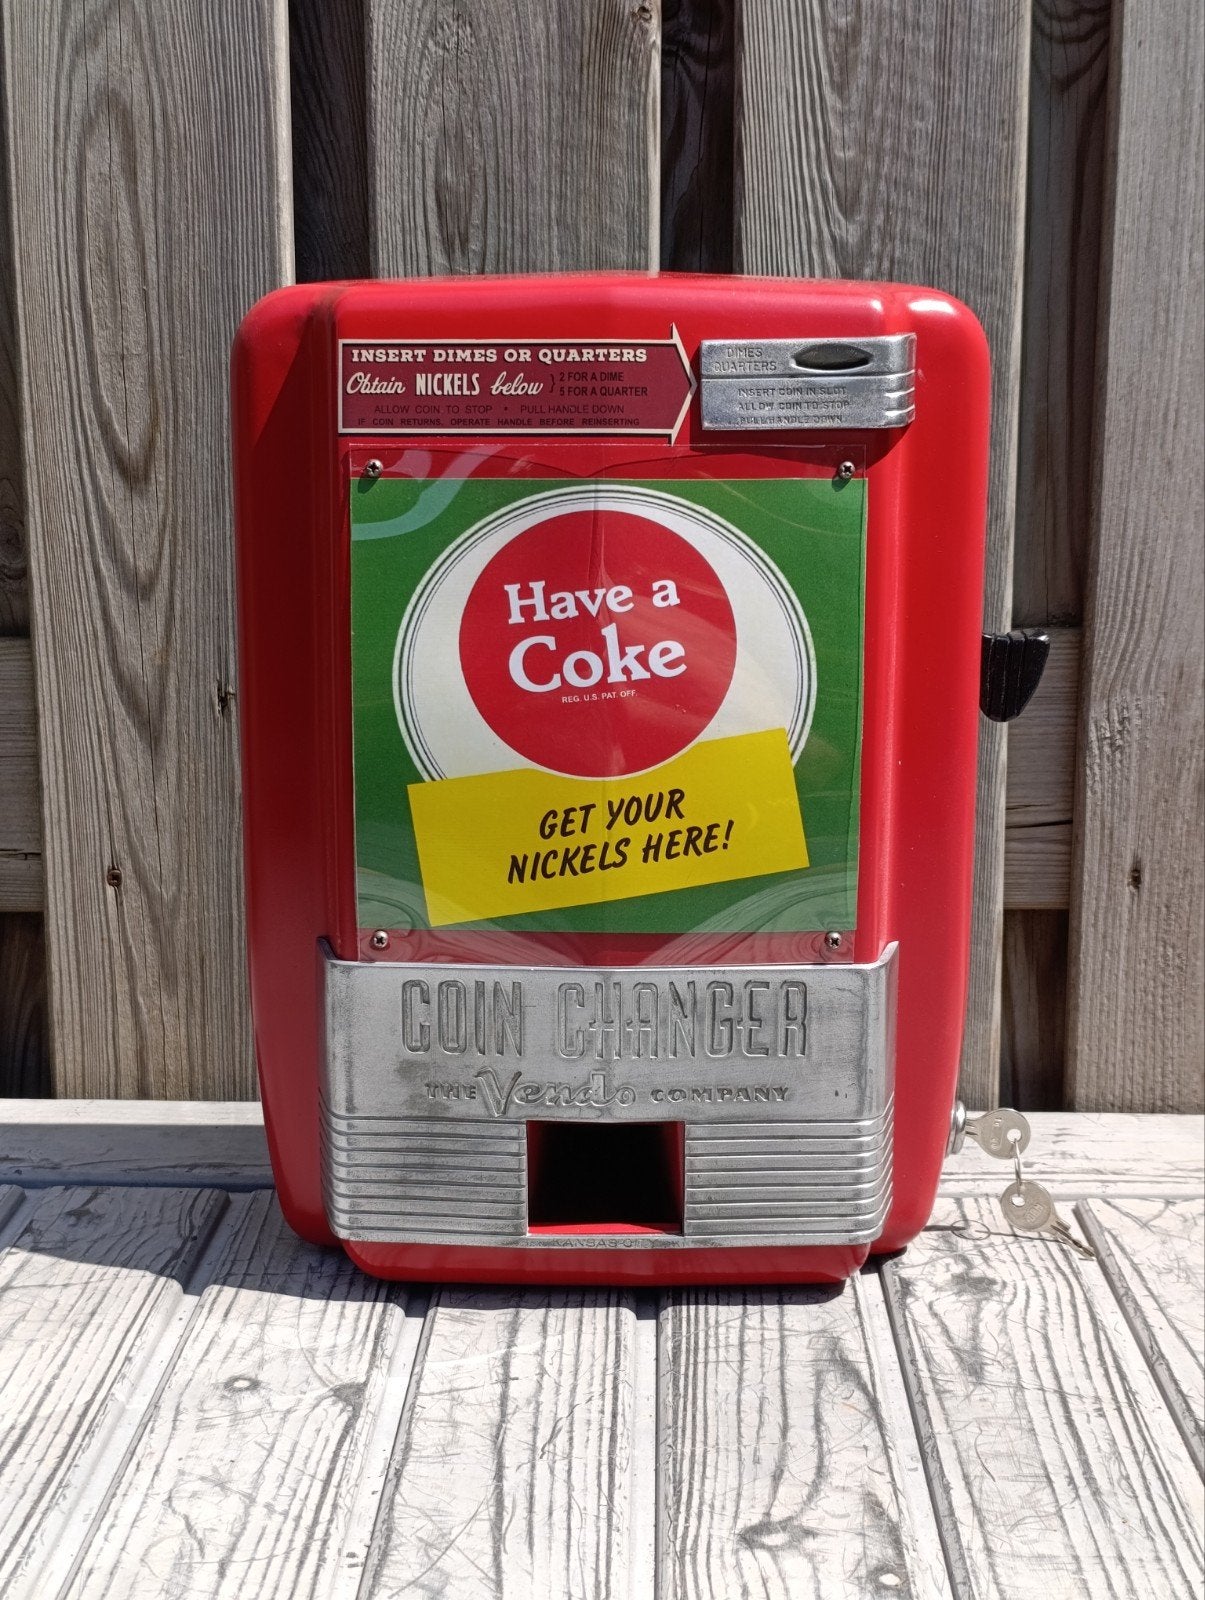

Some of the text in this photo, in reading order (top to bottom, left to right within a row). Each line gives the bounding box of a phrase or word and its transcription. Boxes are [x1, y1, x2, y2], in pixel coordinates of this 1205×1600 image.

[352, 349, 648, 364] INSERT DIMES OR QUARTERS
[727, 348, 763, 359] DIMES
[714, 361, 777, 373] QUARTERS
[559, 372, 624, 382] 2 FOR A DIME
[346, 371, 543, 396] Obtain NICKELS below
[559, 386, 648, 397] 5 FOR A QUARTER
[738, 386, 847, 398] INSERT COIN IN SLOT
[375, 405, 493, 414] ALLOW COIN TO STOP
[520, 404, 625, 414] PULL HANDLE DOWN
[738, 400, 850, 411] ALLOW COIN TO STOP
[358, 418, 366, 426] IF
[372, 418, 394, 426] COIN
[450, 418, 490, 426] OPERATE
[498, 418, 533, 426] HANDLE
[539, 418, 575, 426] BEFORE
[581, 418, 640, 426] REINSERTING
[504, 579, 681, 625] Have a
[508, 622, 687, 693] Coke
[561, 696, 582, 704] REG.
[583, 694, 600, 702] U.S.
[619, 690, 638, 698] OFF.
[539, 788, 686, 840] GET YOUR
[507, 819, 735, 884] NICKELS HERE!
[401, 979, 809, 1060] COIN CHANGER
[425, 1065, 792, 1118] THE Vendo COMPANY
[552, 1237, 617, 1248] KANSAS
